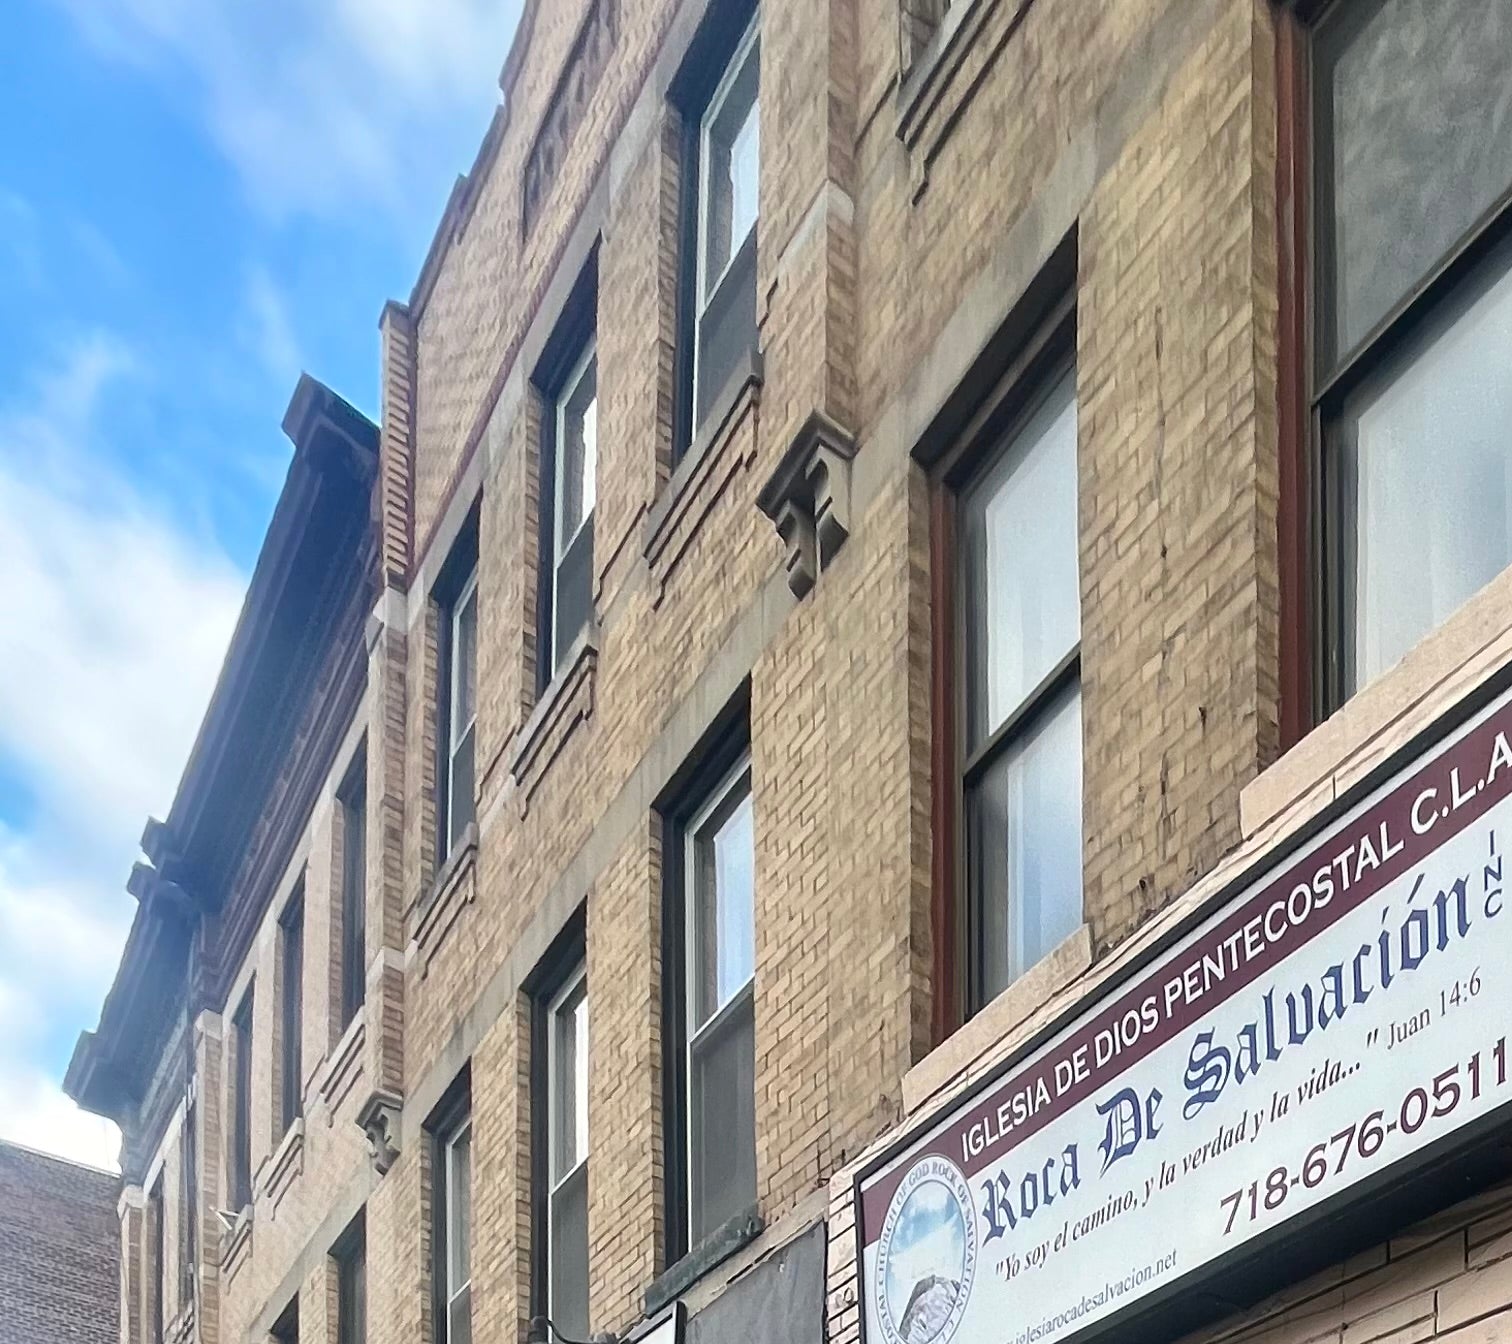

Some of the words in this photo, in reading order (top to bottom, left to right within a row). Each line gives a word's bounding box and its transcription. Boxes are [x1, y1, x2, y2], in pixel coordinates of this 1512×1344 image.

[1484, 830, 1502, 918] INC
[962, 1077, 1051, 1161] IGLESIA
[1054, 1045, 1090, 1097] DE
[1094, 995, 1159, 1069] DIOS
[1164, 821, 1404, 1018] PENTECOSTAL
[981, 1143, 1081, 1247] Roca
[1096, 1087, 1165, 1179] De
[1183, 873, 1472, 1121] Salvación
[1387, 1008, 1431, 1049] Juan
[1440, 965, 1482, 1016] 14:6
[1024, 1240, 1049, 1272] soy
[1054, 1221, 1067, 1252] el
[1072, 1189, 1138, 1242] camino,
[1142, 1175, 1154, 1207] y
[1159, 1160, 1175, 1189] la
[1183, 1110, 1249, 1175] verdad
[1250, 1110, 1264, 1142] y
[1270, 1092, 1289, 1122] la
[1220, 1036, 1508, 1235] 718-676-0511
